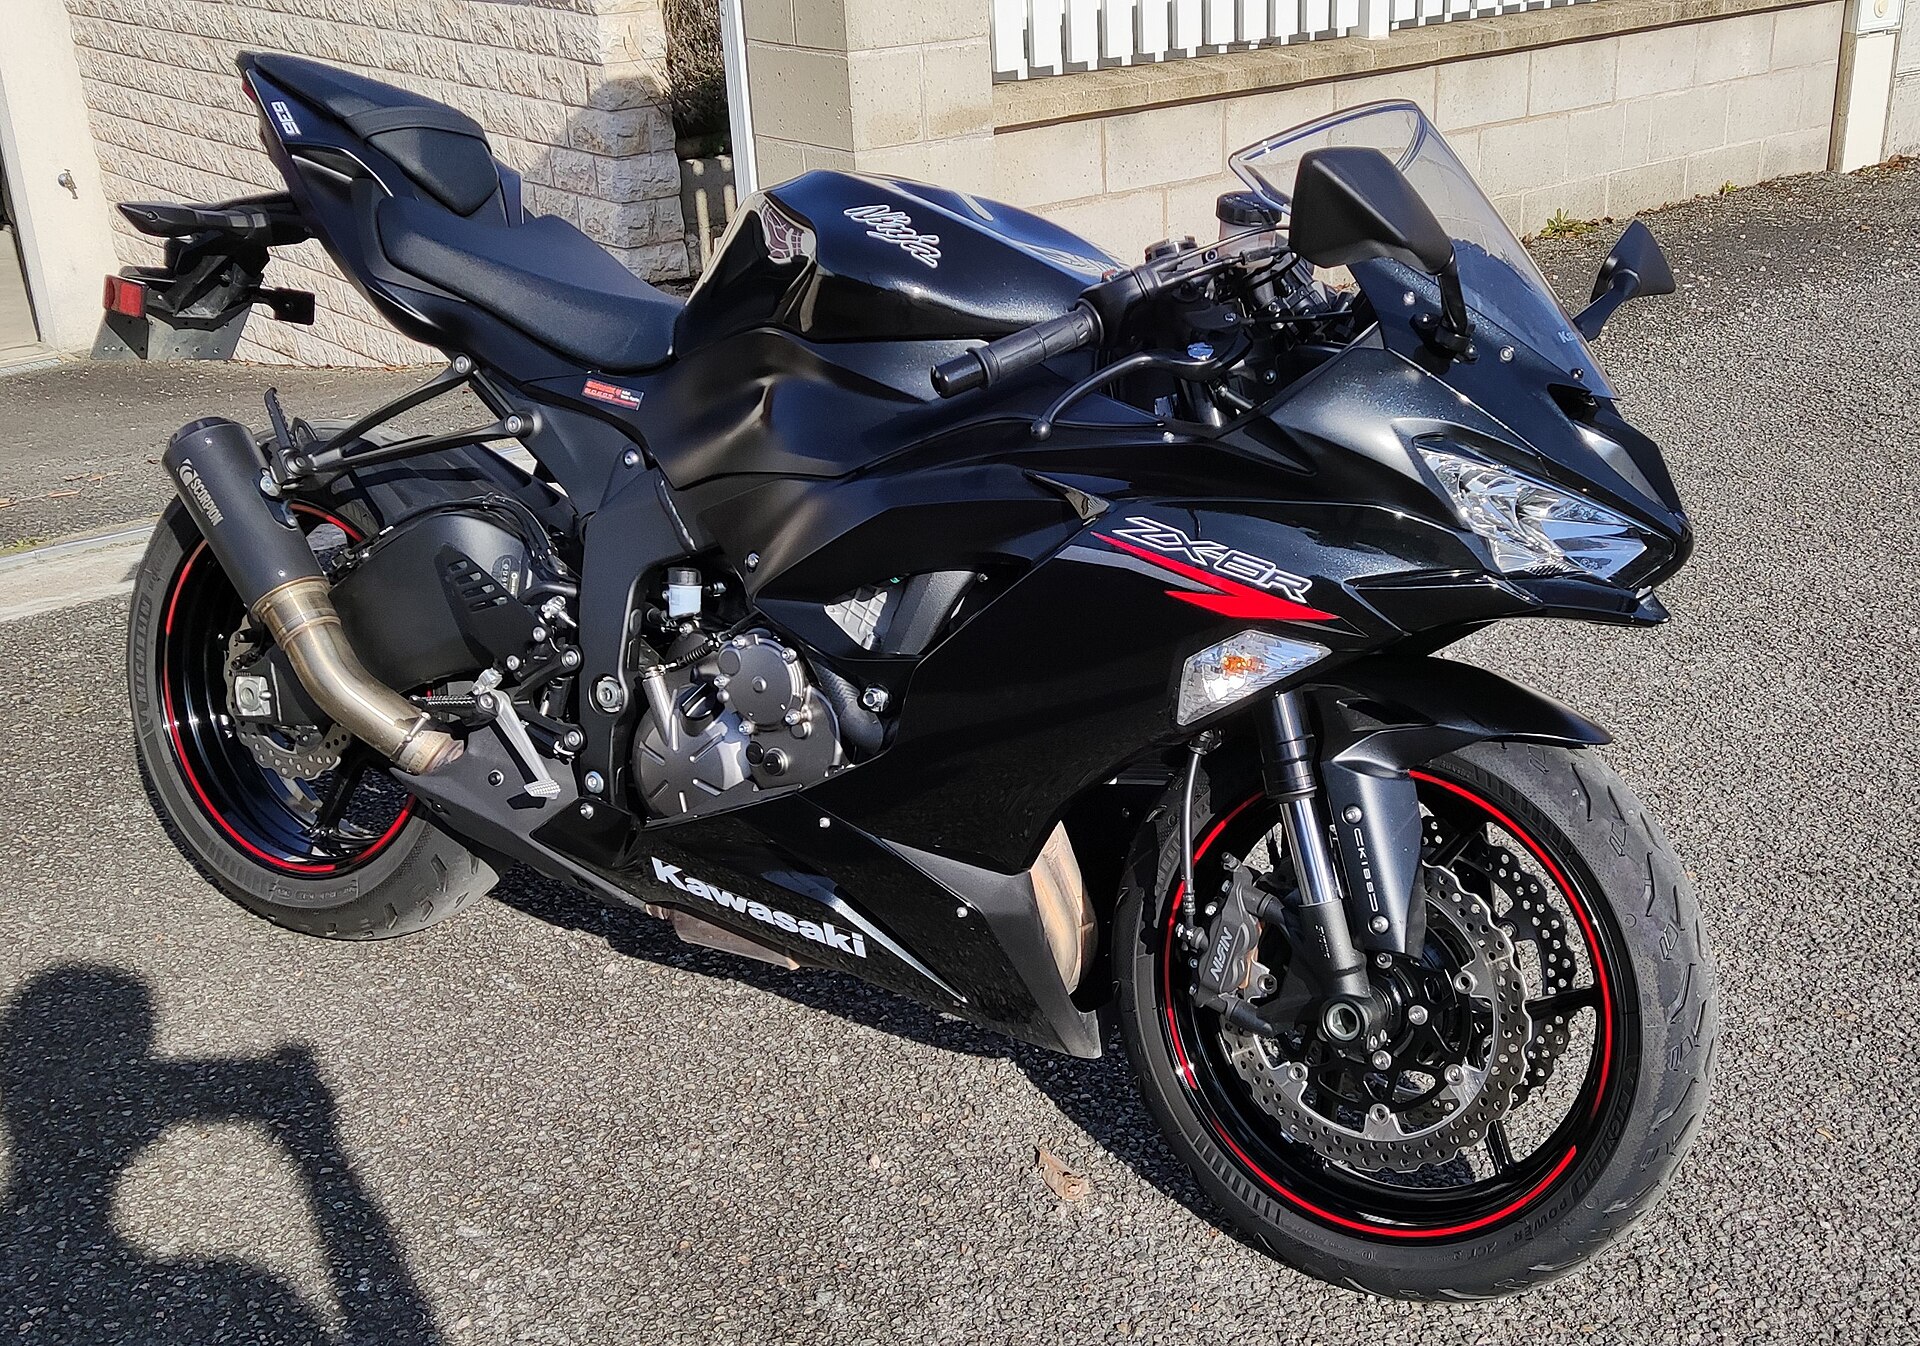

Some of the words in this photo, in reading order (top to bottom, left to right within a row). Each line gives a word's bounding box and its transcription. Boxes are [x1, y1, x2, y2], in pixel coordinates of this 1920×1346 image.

[271, 101, 302, 136] 636
[843, 204, 942, 269] Ninja
[190, 477, 224, 527] SCORPION
[1112, 516, 1313, 604] ZX-6R
[134, 596, 152, 703] MICHELIN
[650, 856, 867, 959] Kawasaki
[1210, 926, 1233, 982] NISSIN
